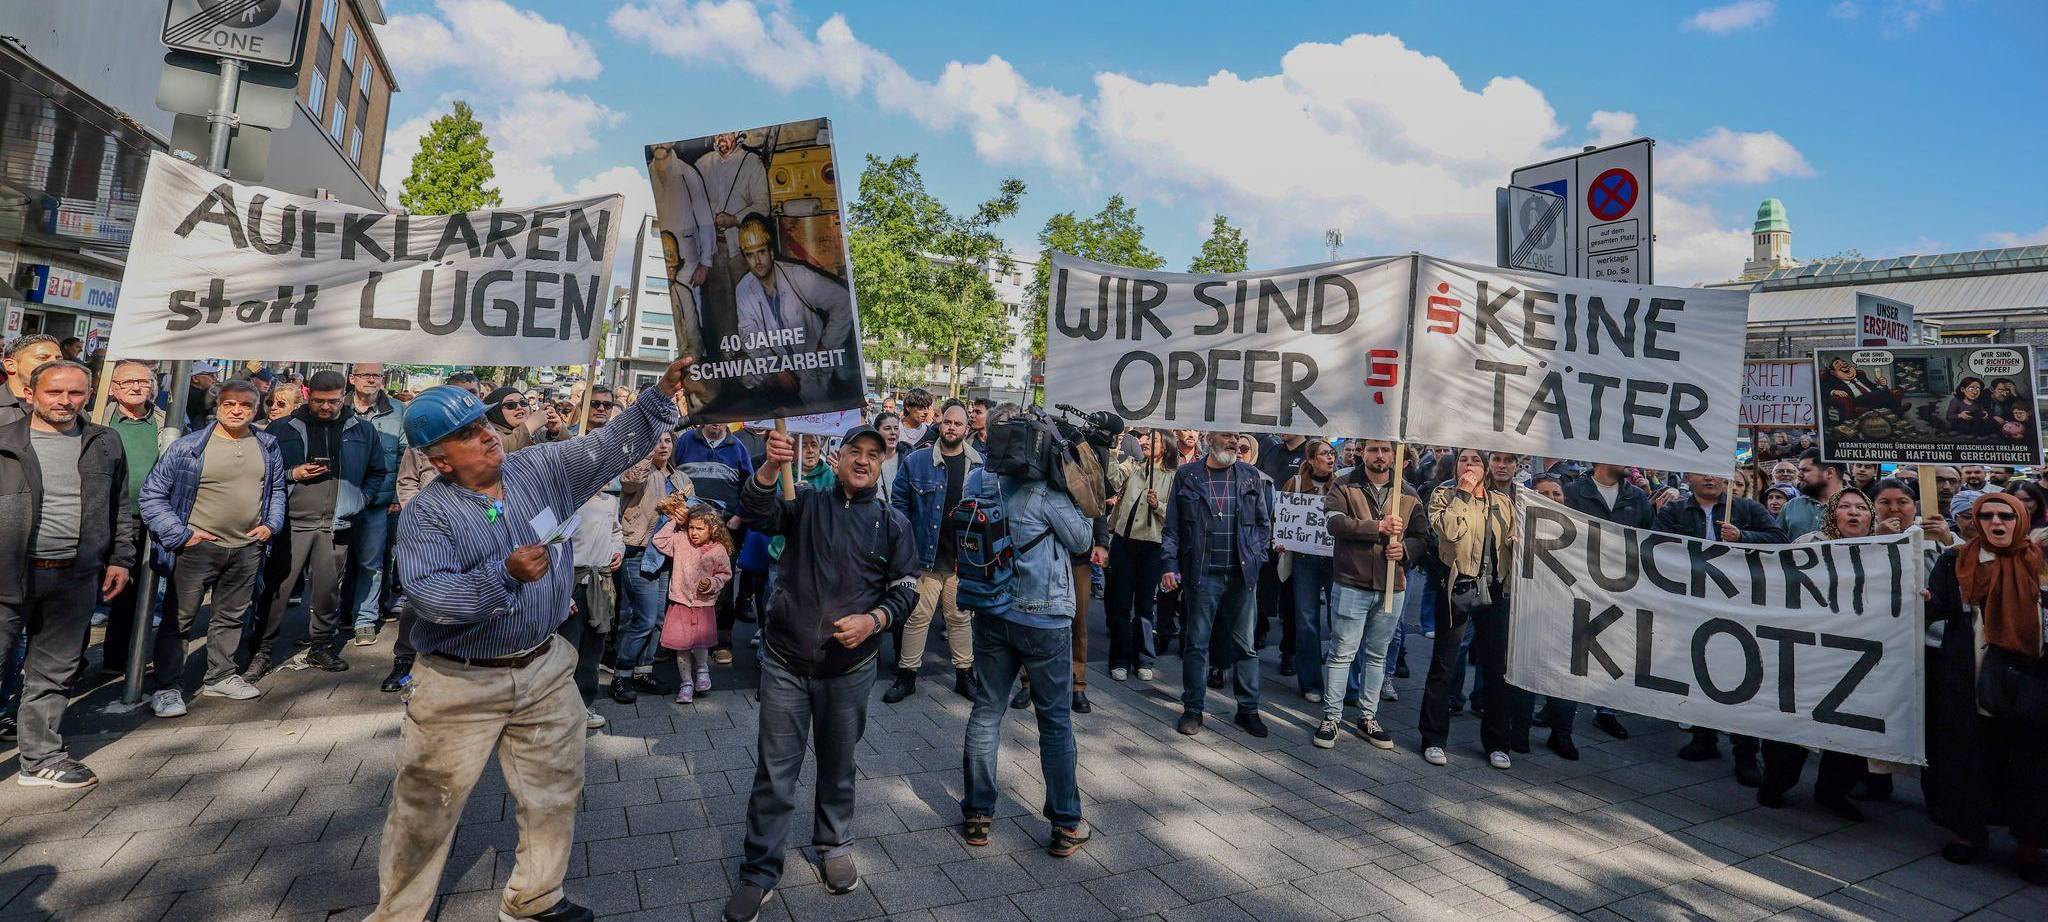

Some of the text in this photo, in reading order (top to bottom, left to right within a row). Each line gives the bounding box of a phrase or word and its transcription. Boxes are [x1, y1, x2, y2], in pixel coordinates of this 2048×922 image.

[198, 29, 264, 53] ZONE
[1591, 234, 1635, 247] gesamten Platz
[1601, 228, 1610, 236] auf
[1526, 254, 1553, 268] ZONE
[1597, 255, 1628, 264] werktags
[167, 278, 319, 331] statt
[359, 260, 600, 341] LÜGEN
[1055, 269, 1360, 341] WIR SIND
[1876, 303, 1899, 321] UNSER
[1475, 281, 1686, 362] KEINE
[1863, 315, 1909, 343] ERSPARTES
[720, 327, 806, 353] 40 JAHRE
[690, 349, 846, 381] SCHWARZARBEIT
[1743, 364, 1793, 387] RHEIT
[1111, 349, 1328, 428] OPFER
[1752, 392, 1777, 402] oder
[1783, 395, 1806, 403] nur
[1475, 360, 1709, 452] TÄTER
[1835, 448, 2031, 461] AUFKLÄRUNG HAFTUNG GERECHTIGKEIT
[1895, 442, 1935, 450] ÜBERNEHMEN
[1996, 444, 2028, 452] ERKLÄREN
[1280, 493, 1315, 506] Mehr
[1280, 508, 1300, 523] für
[1277, 527, 1293, 540] als
[1295, 527, 1311, 542] für
[1570, 598, 1886, 734] KLOTZ
